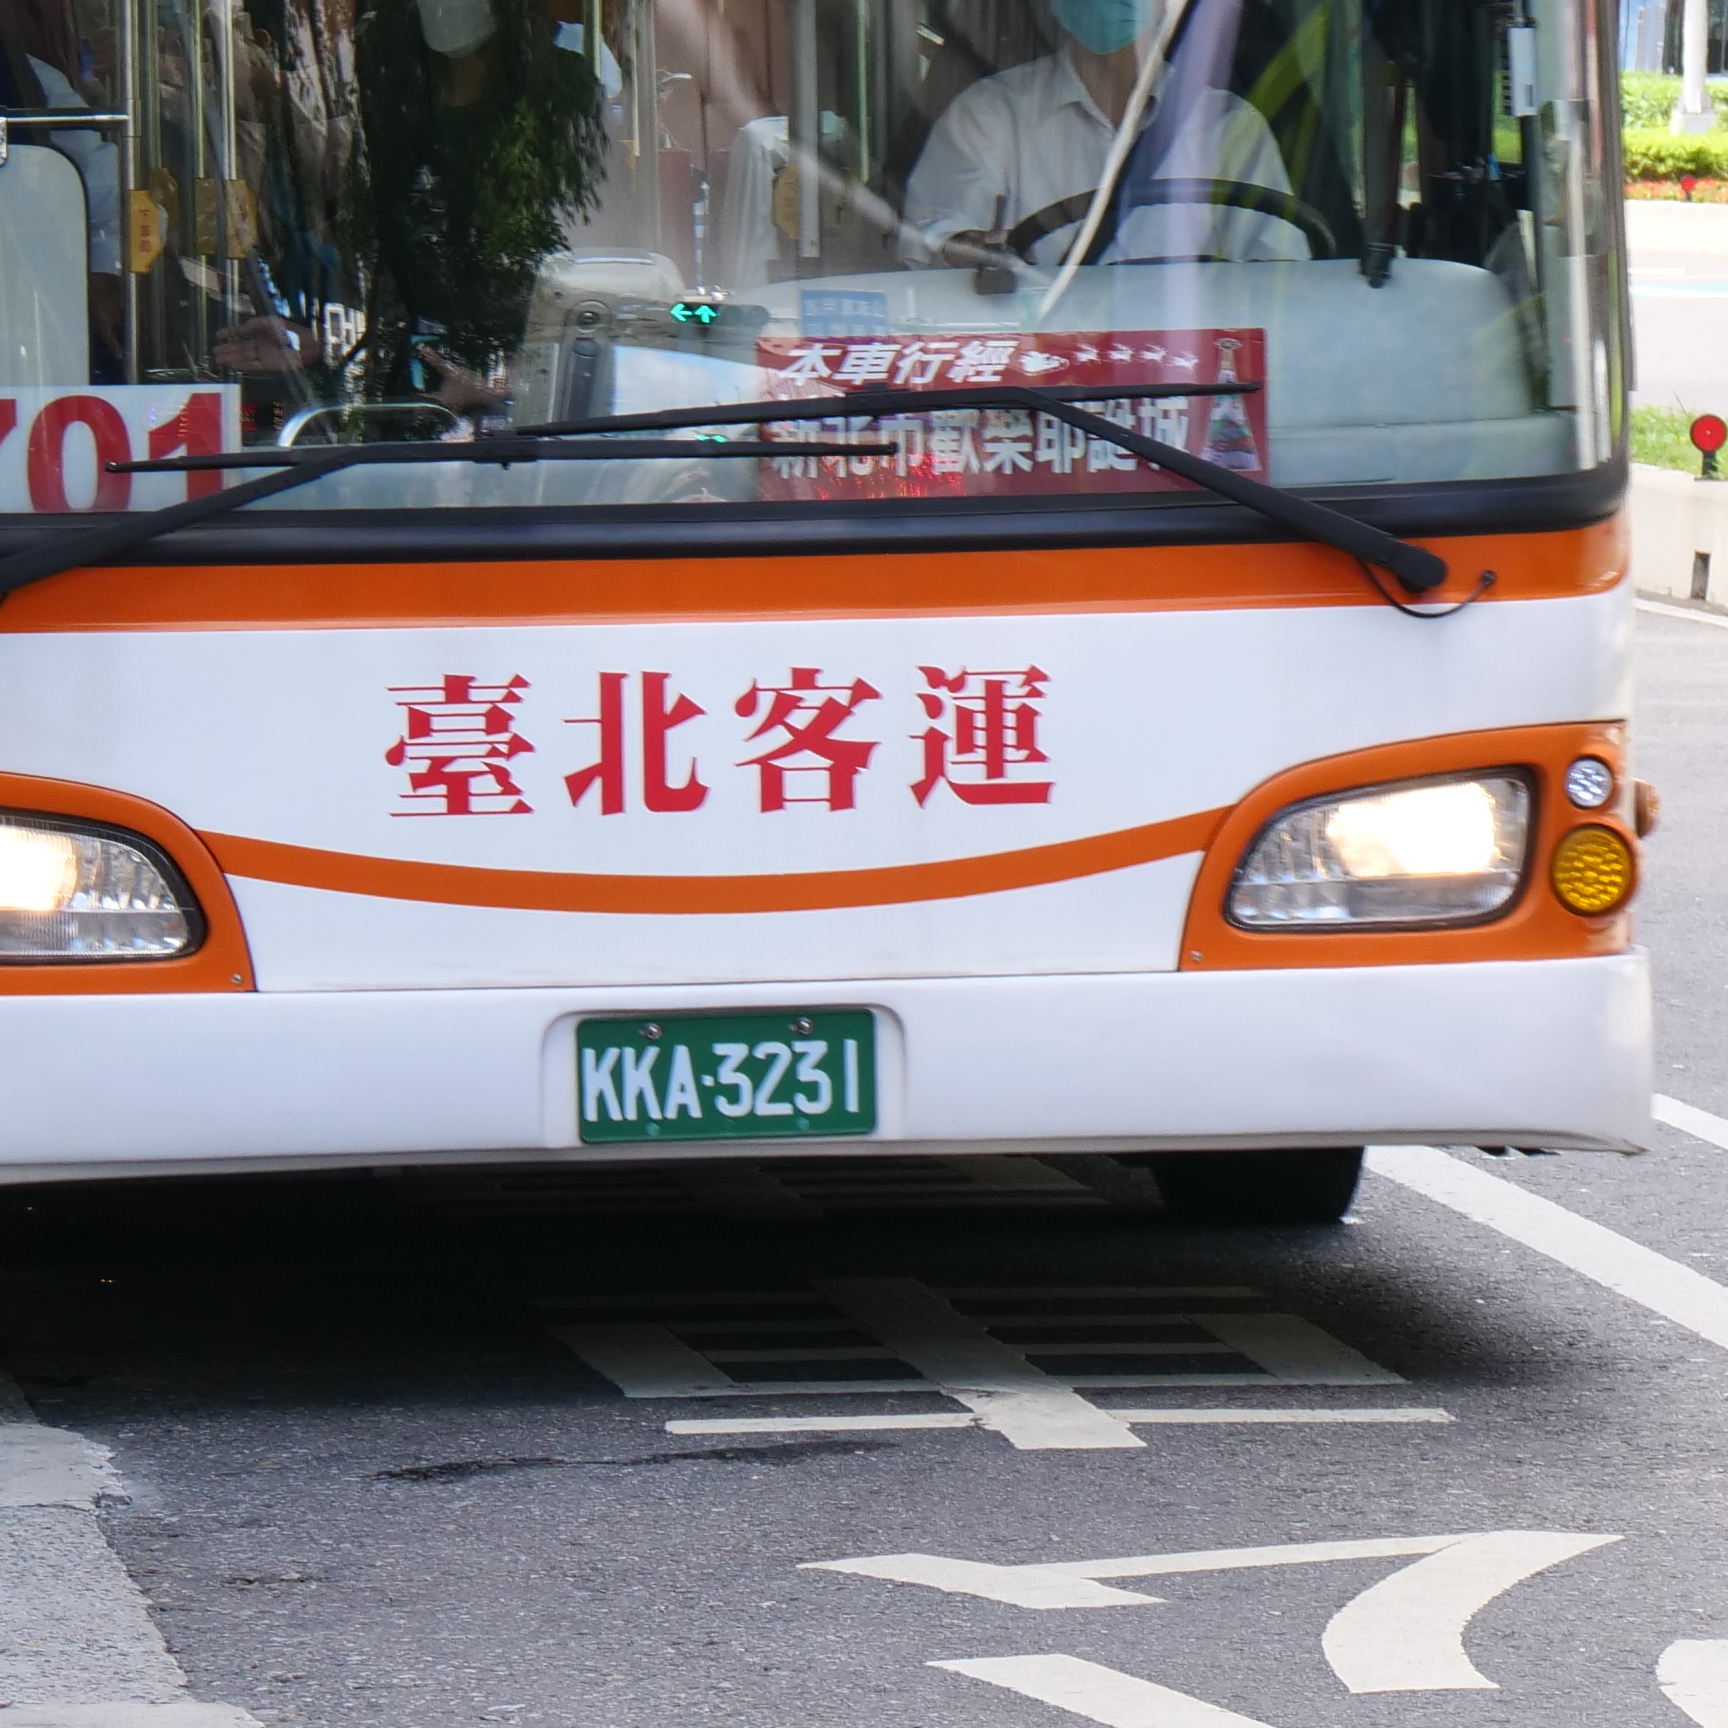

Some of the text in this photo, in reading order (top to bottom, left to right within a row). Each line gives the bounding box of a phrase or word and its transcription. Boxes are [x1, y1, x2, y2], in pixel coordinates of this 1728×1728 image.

[780, 339, 1019, 387] 本車行經
[385, 665, 1055, 815] 臺北客運
[582, 1038, 860, 1122] KKA-3231
